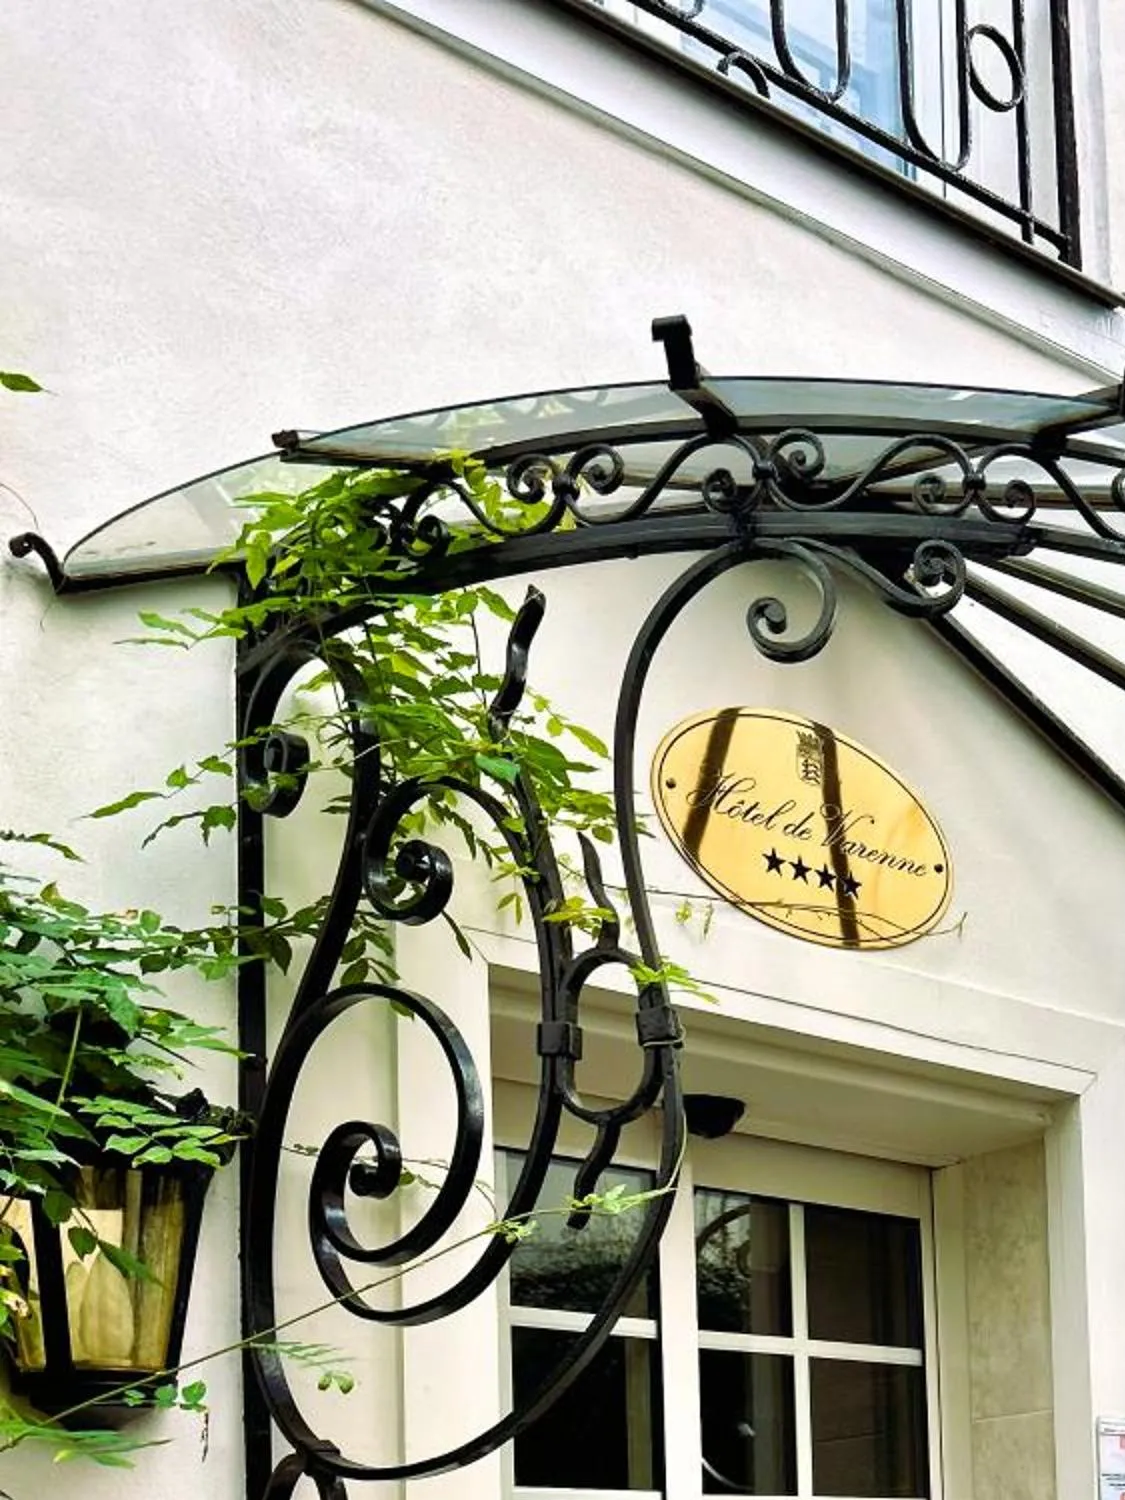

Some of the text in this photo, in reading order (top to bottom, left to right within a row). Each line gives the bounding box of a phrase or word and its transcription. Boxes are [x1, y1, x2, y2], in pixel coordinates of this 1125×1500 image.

[686, 771, 928, 877] Hôtel de Varenne
